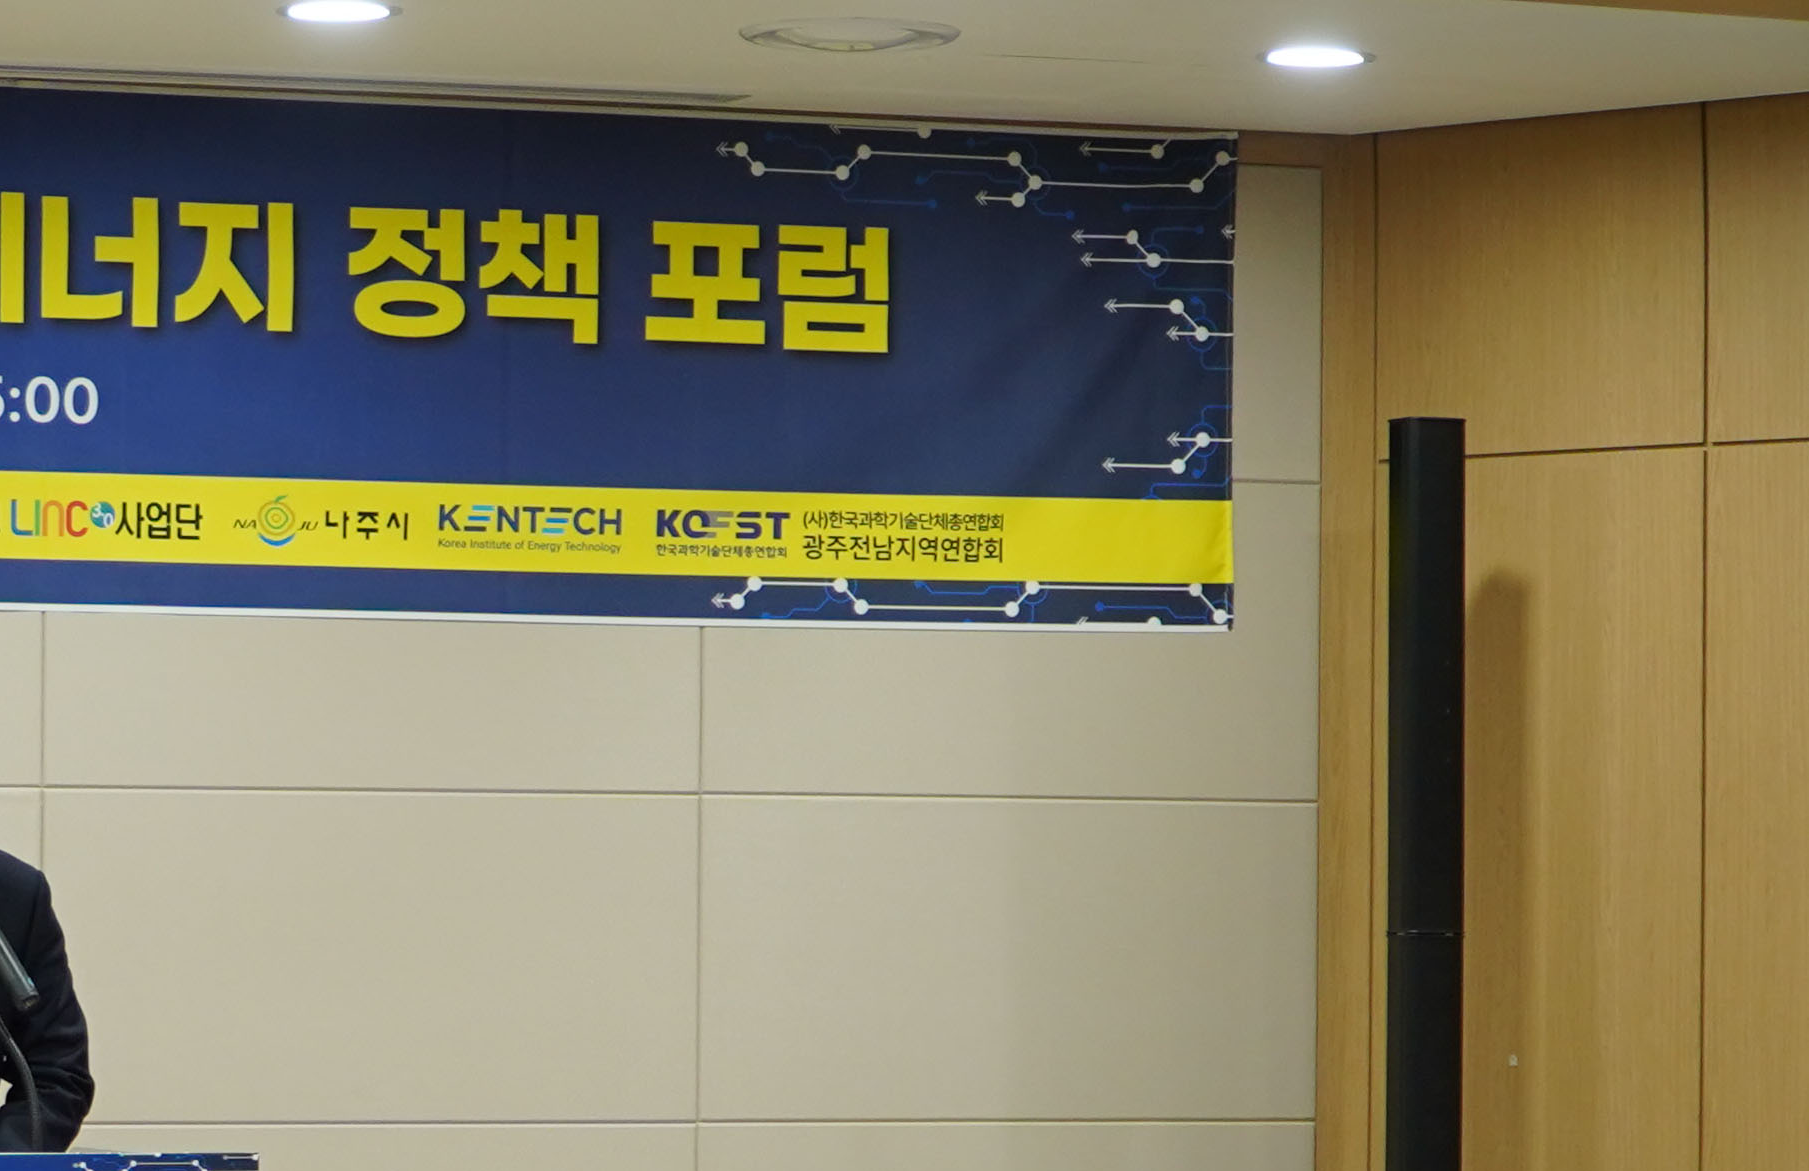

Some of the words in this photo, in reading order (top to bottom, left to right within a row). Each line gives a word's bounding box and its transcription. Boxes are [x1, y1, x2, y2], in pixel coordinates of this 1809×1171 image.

[348, 205, 600, 345] 정책
[644, 219, 890, 354] 포럼
[115, 501, 203, 541] 사업단
[325, 510, 409, 541] 나주시
[438, 503, 623, 536] KENTECH
[802, 510, 1005, 532] (사)한국과학기술단체총연합회
[438, 538, 467, 549] Korea
[470, 538, 511, 550] Institute
[514, 540, 525, 550] of
[528, 541, 561, 553] Energy
[564, 541, 622, 554] Technology
[656, 543, 788, 559] 한국과학기술단체총연합회
[802, 534, 1004, 564] 광주전남지역연합회
